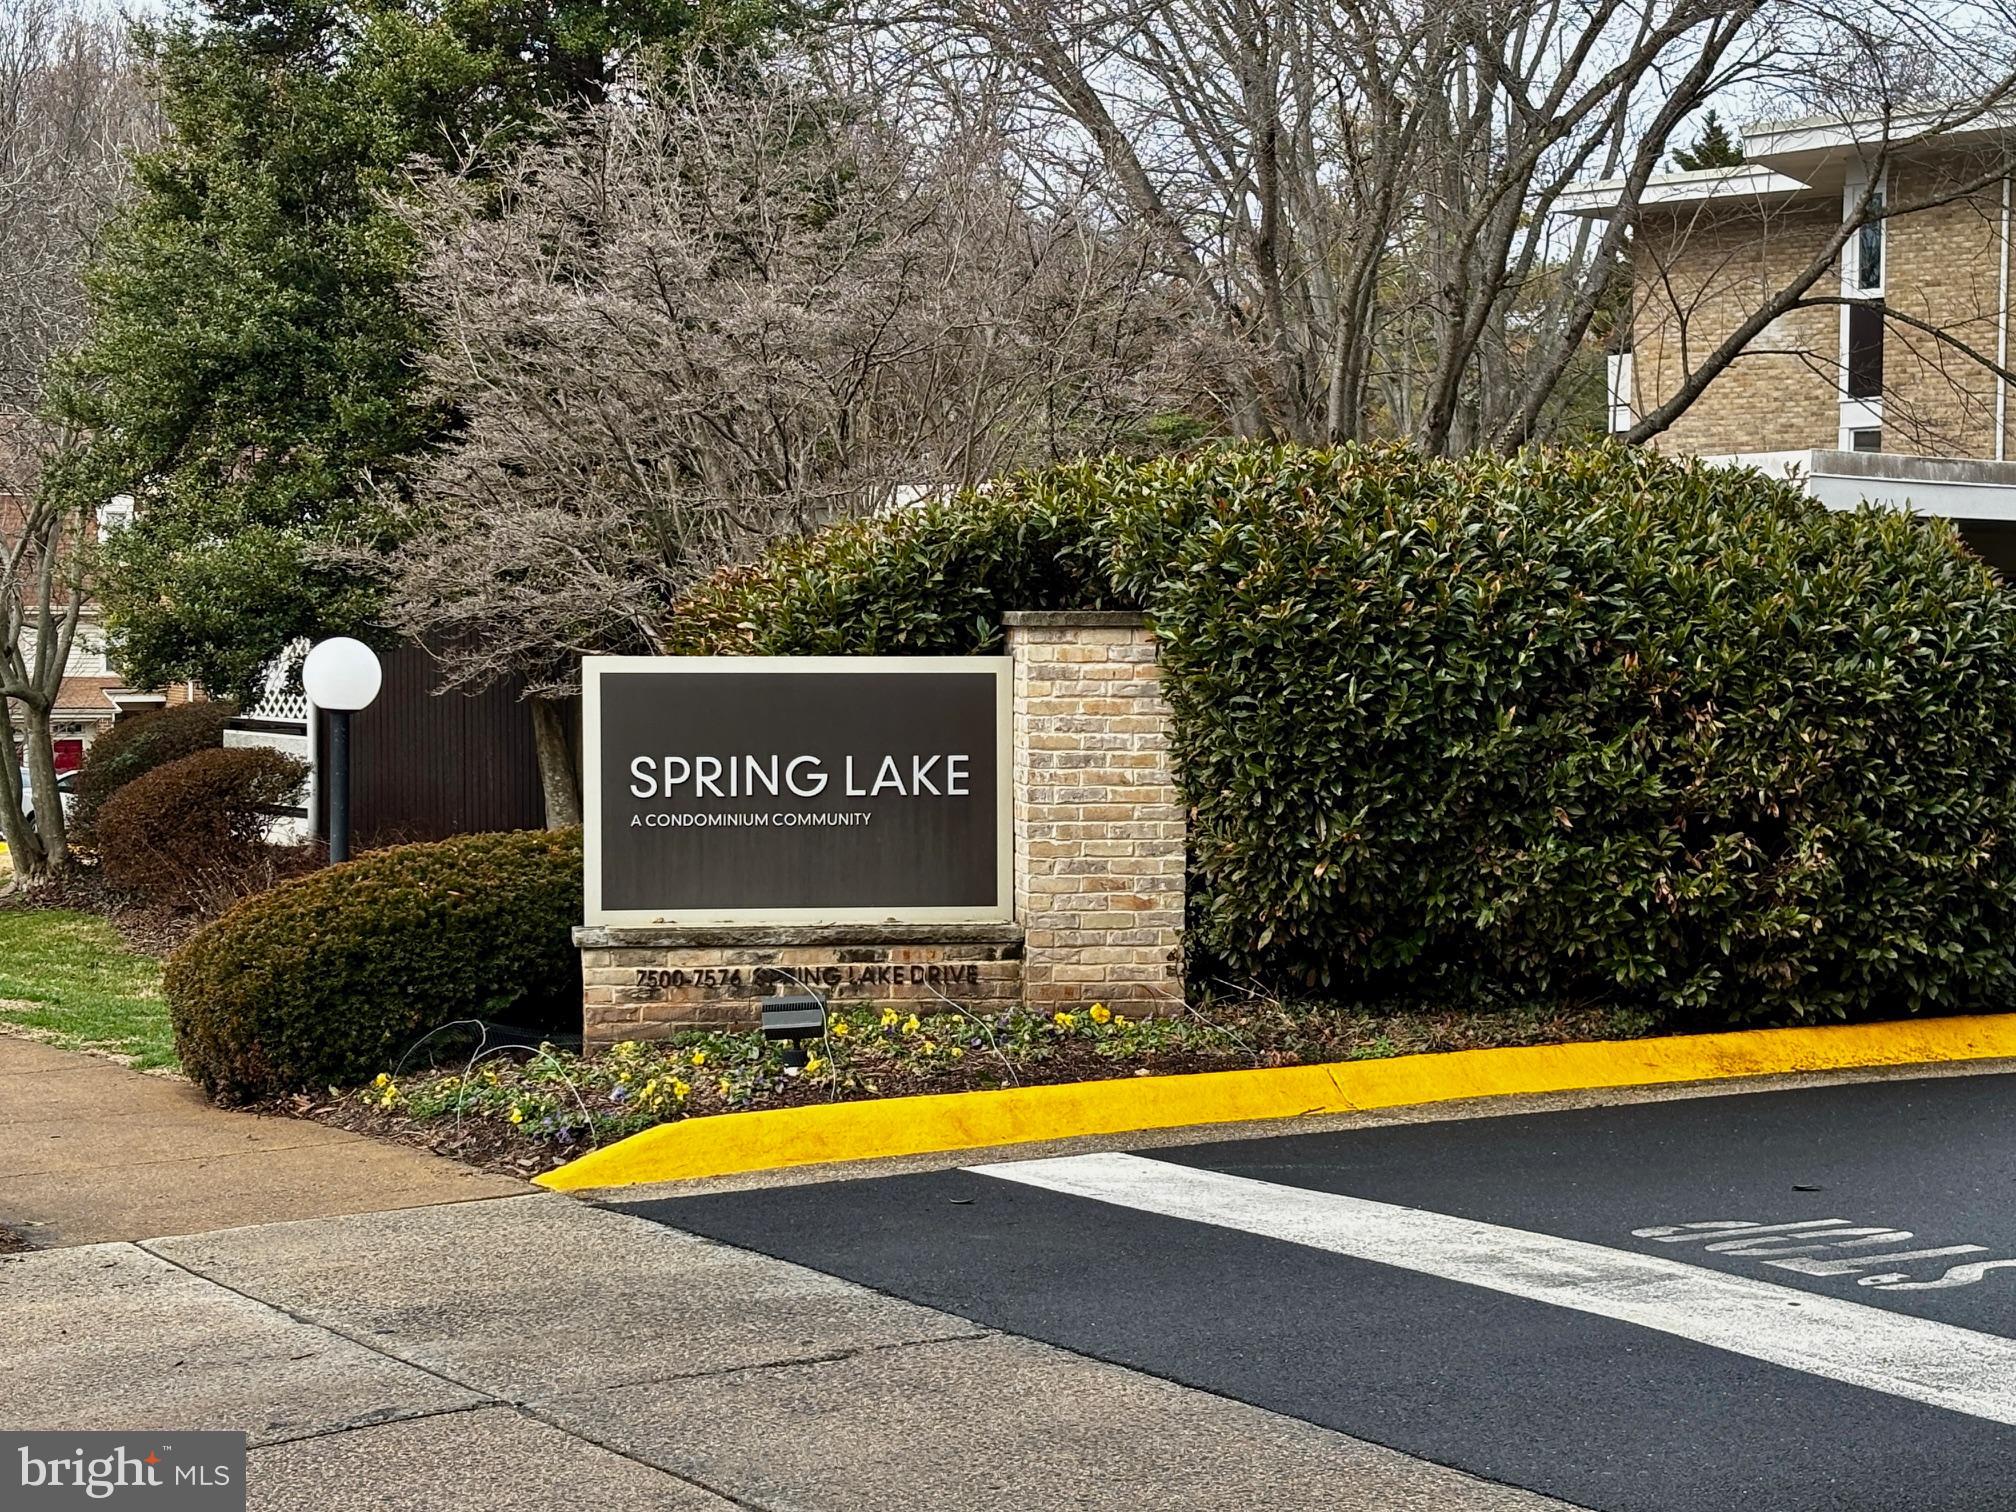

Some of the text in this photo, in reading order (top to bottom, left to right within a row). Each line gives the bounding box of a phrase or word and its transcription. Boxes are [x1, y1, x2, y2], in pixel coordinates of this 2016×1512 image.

[630, 754, 970, 799] SPRING LAKE
[630, 812, 872, 828] A CONDOMINIUM COMMUNITY
[849, 965, 905, 986] LAKE
[910, 964, 979, 986] DRIVE
